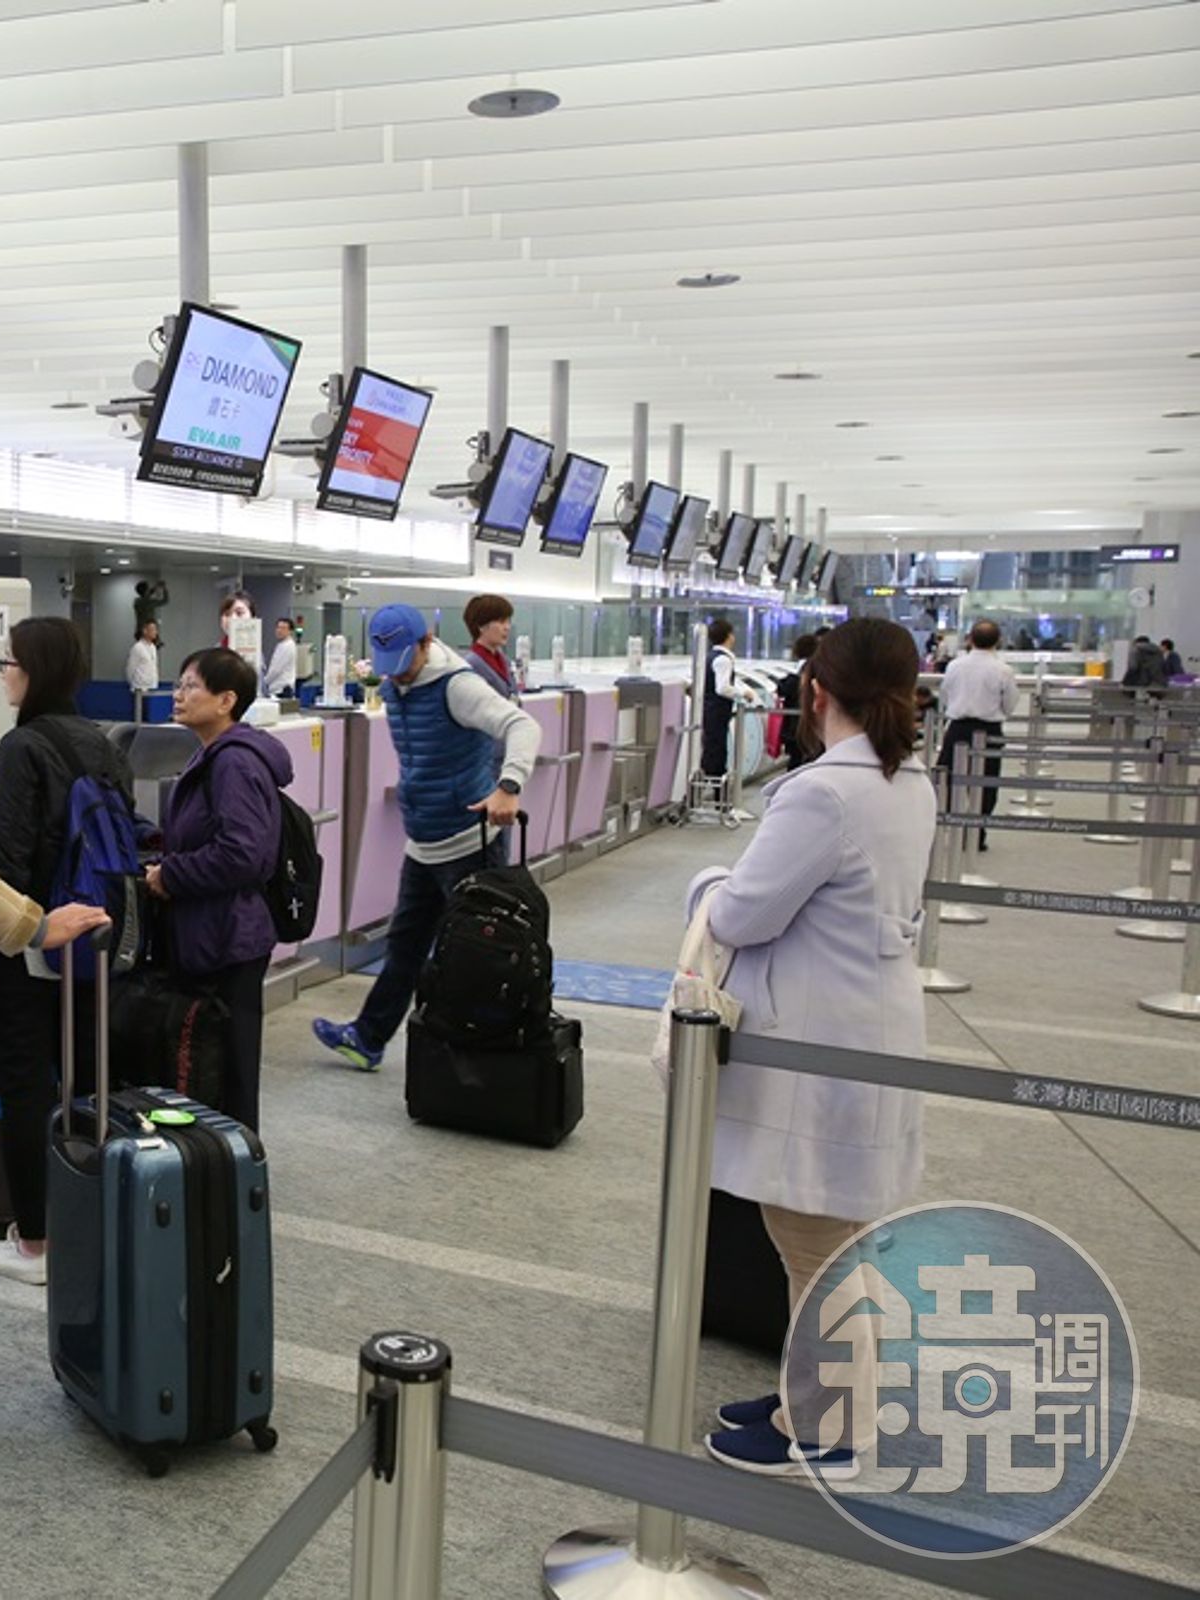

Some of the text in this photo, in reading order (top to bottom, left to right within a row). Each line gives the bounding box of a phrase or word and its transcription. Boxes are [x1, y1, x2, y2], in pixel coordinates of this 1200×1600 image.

[201, 355, 279, 399] DIAMOND
[188, 425, 241, 450] EVA AIR
[1131, 901, 1182, 917] Taiwan
